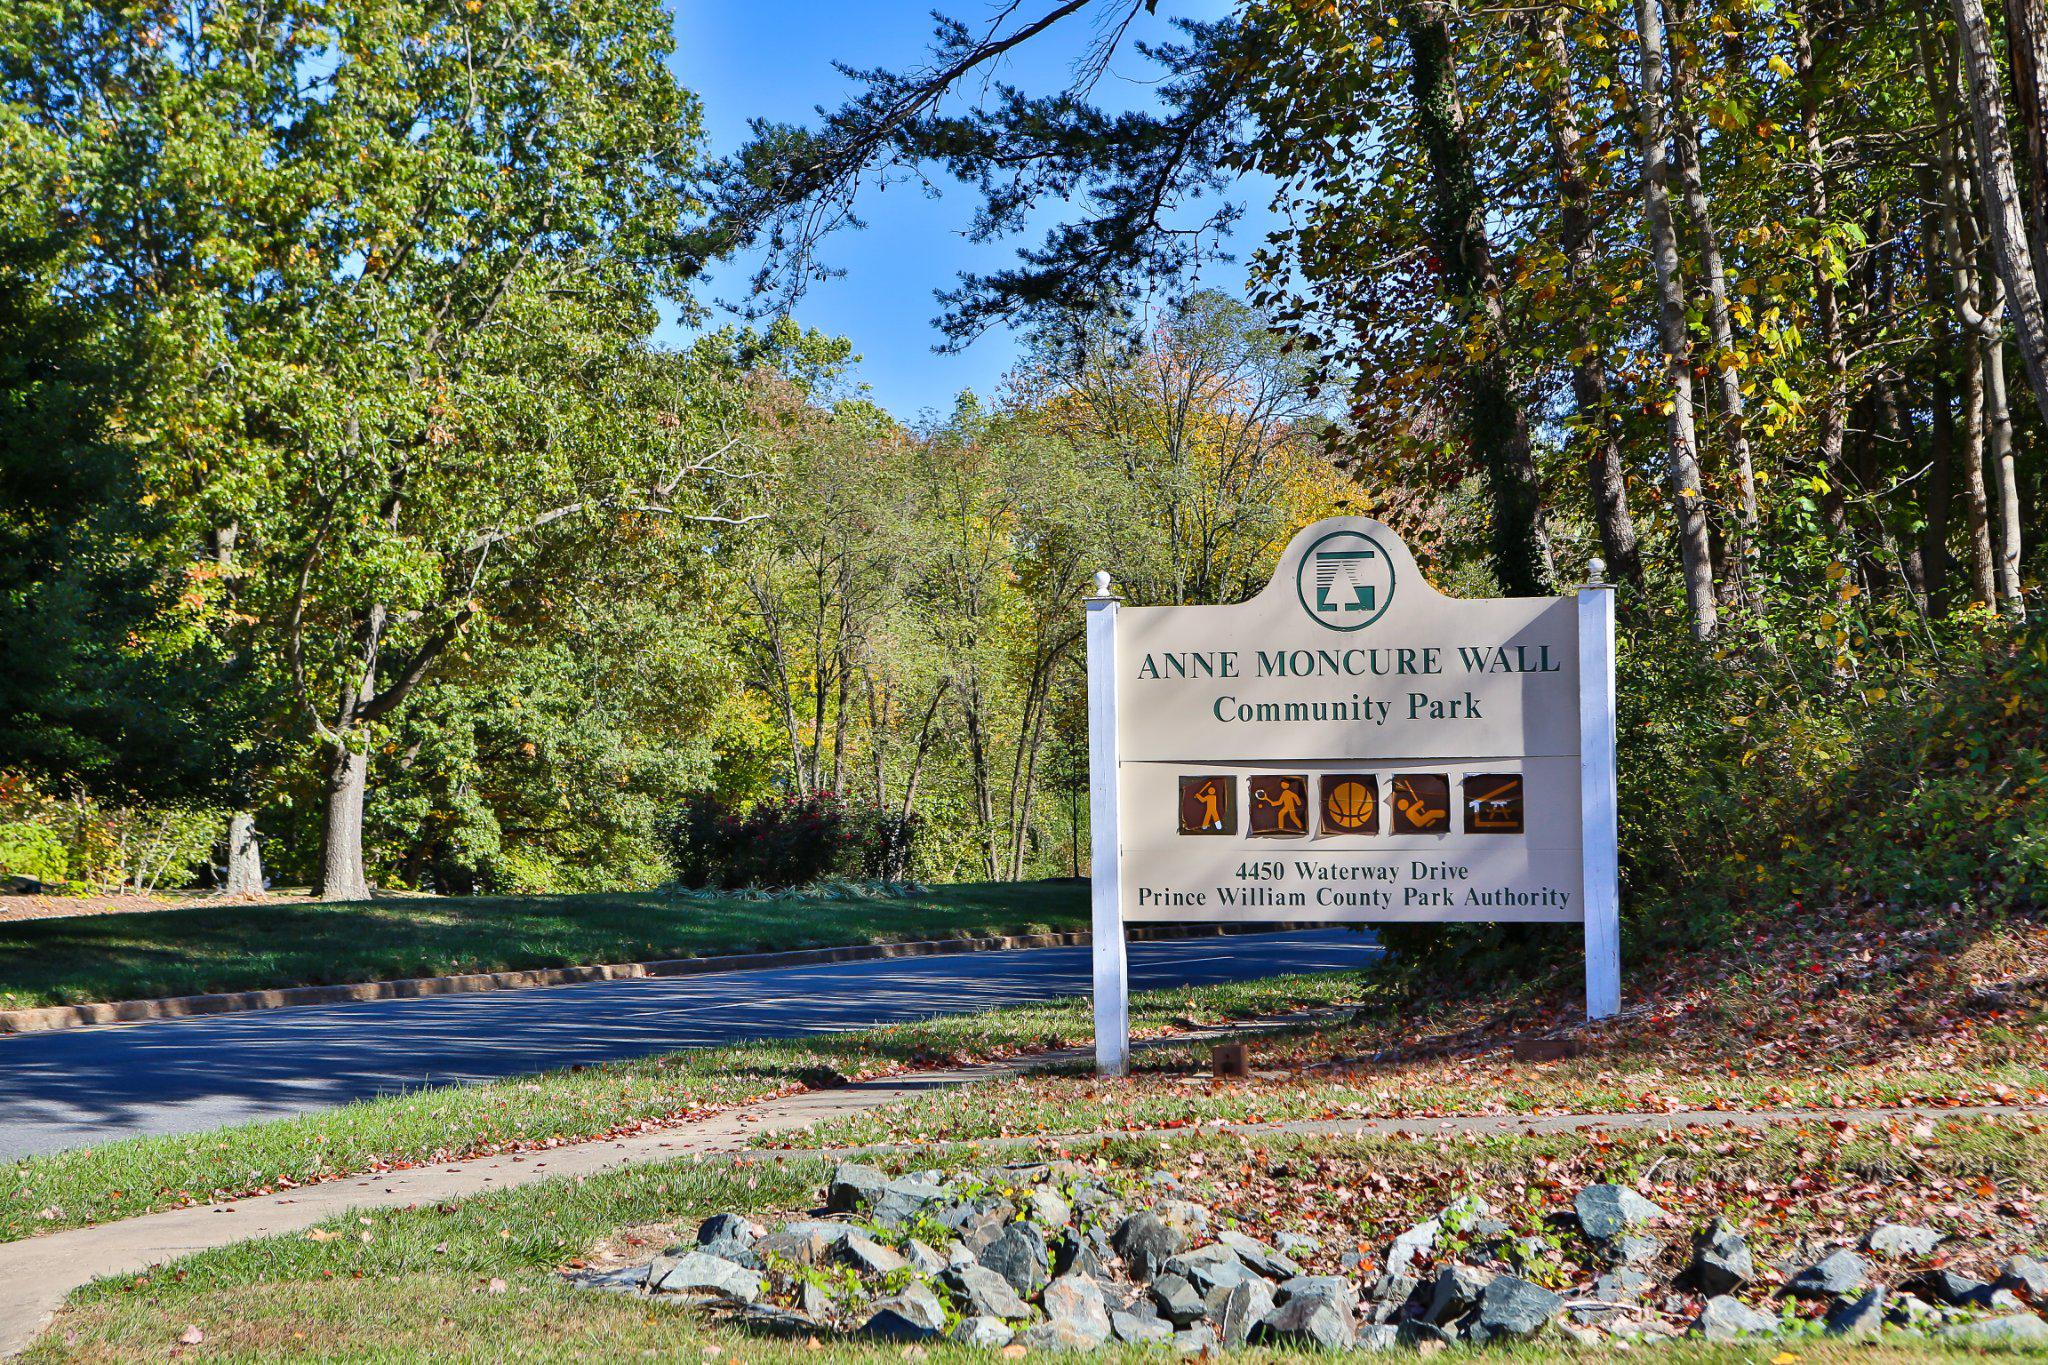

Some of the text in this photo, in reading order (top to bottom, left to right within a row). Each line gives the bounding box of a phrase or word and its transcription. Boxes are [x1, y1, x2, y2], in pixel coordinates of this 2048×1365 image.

[1137, 645, 1560, 679] ANNE MONCURE WALL
[1213, 692, 1483, 726] Community Park
[1235, 861, 1469, 884] 4450 Waterway Drive
[1138, 886, 1571, 910] Prince William County Park Authority
